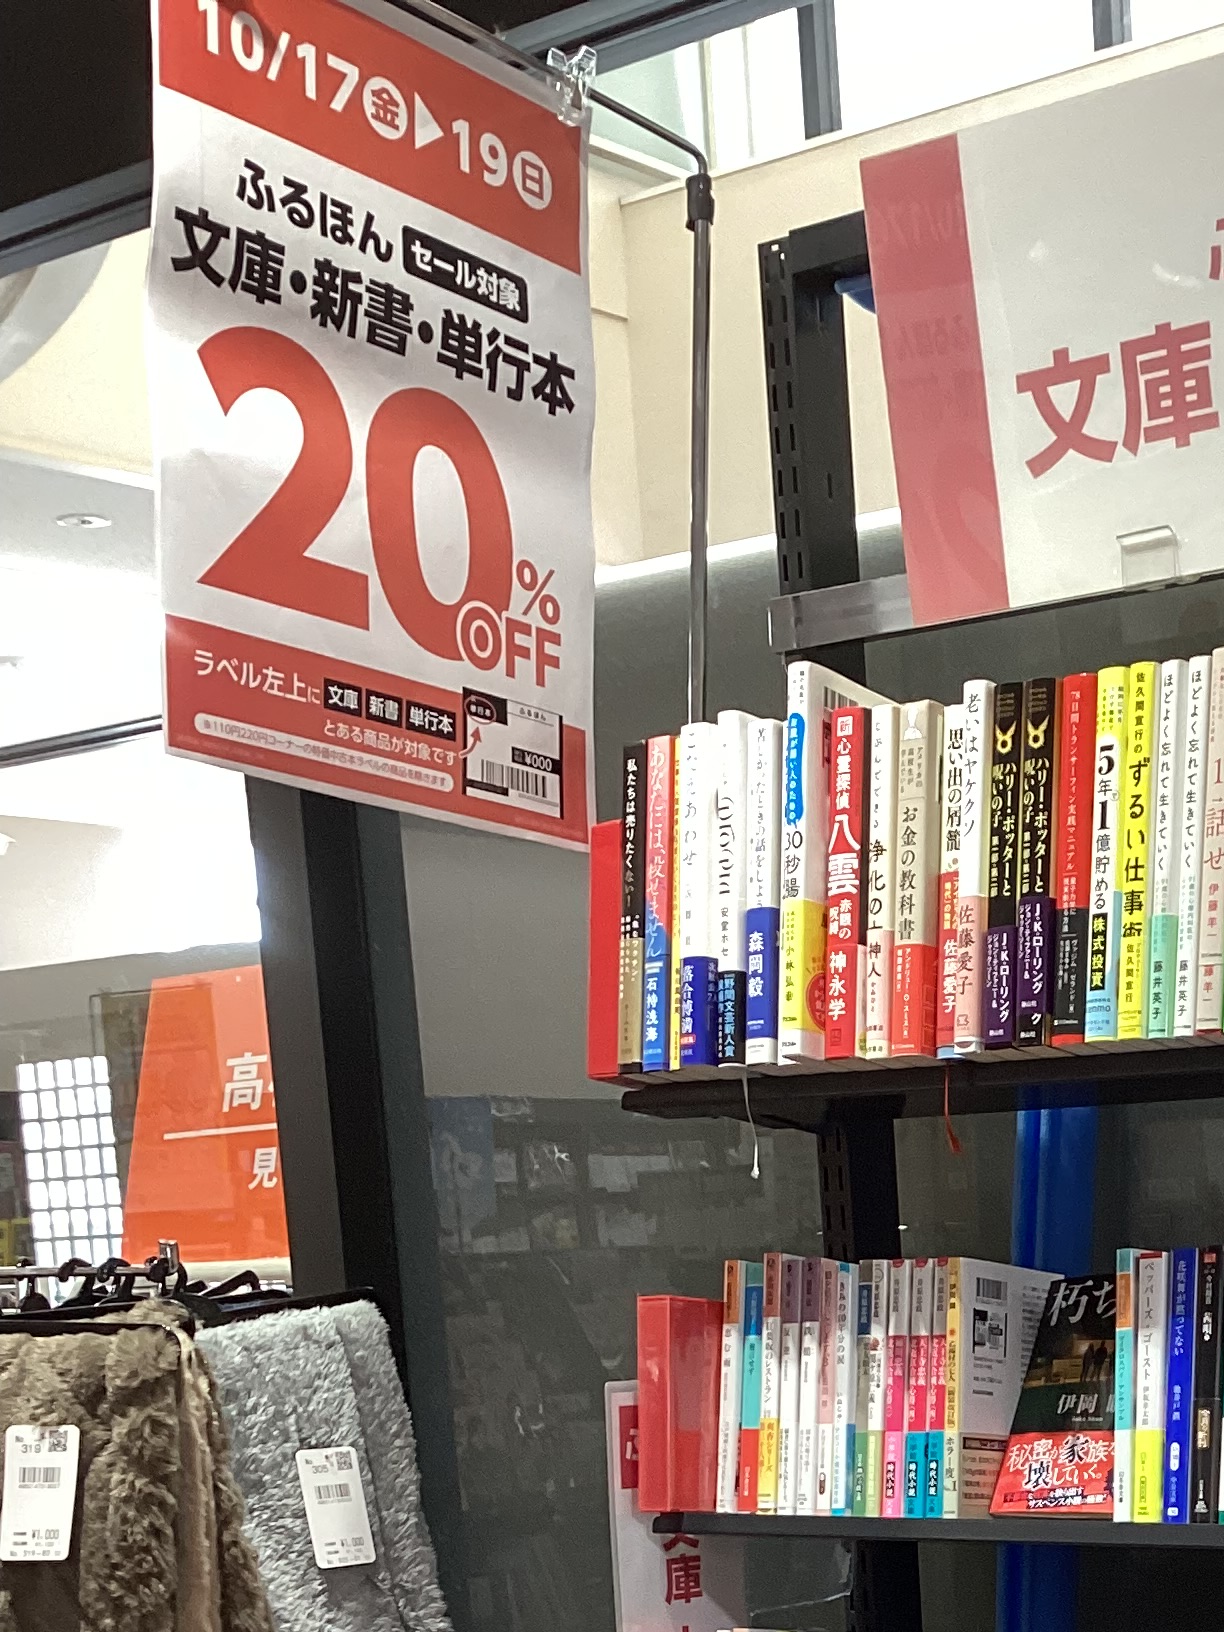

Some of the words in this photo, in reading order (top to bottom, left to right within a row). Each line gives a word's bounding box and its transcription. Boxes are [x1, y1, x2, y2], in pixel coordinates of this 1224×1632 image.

[235, 157, 395, 261] ふるほん
[407, 241, 523, 310] セール対象
[1014, 320, 1220, 479] 文庫
[197, 326, 513, 662] 20
[516, 560, 562, 625] %
[194, 649, 321, 705] ラベル左上に
[456, 600, 562, 688] OFF
[327, 685, 359, 710] 文庫
[368, 695, 399, 720] 新書
[409, 706, 454, 735] 単行本
[324, 719, 455, 766] とある商品が対象です
[964, 693, 981, 838] 老いはヤケクソ
[1157, 674, 1173, 870] ほどよく忘れて生きていく
[1184, 670, 1203, 868] ほどよく忘れて生きていく
[899, 806, 918, 940] お金の教科書
[957, 904, 975, 995] 佐藤愛子
[1090, 916, 1106, 988] 株式投資
[828, 950, 846, 1021] 神永学
[1152, 960, 1163, 1019] 藤井英子
[1177, 960, 1188, 1017] 藤井英子
